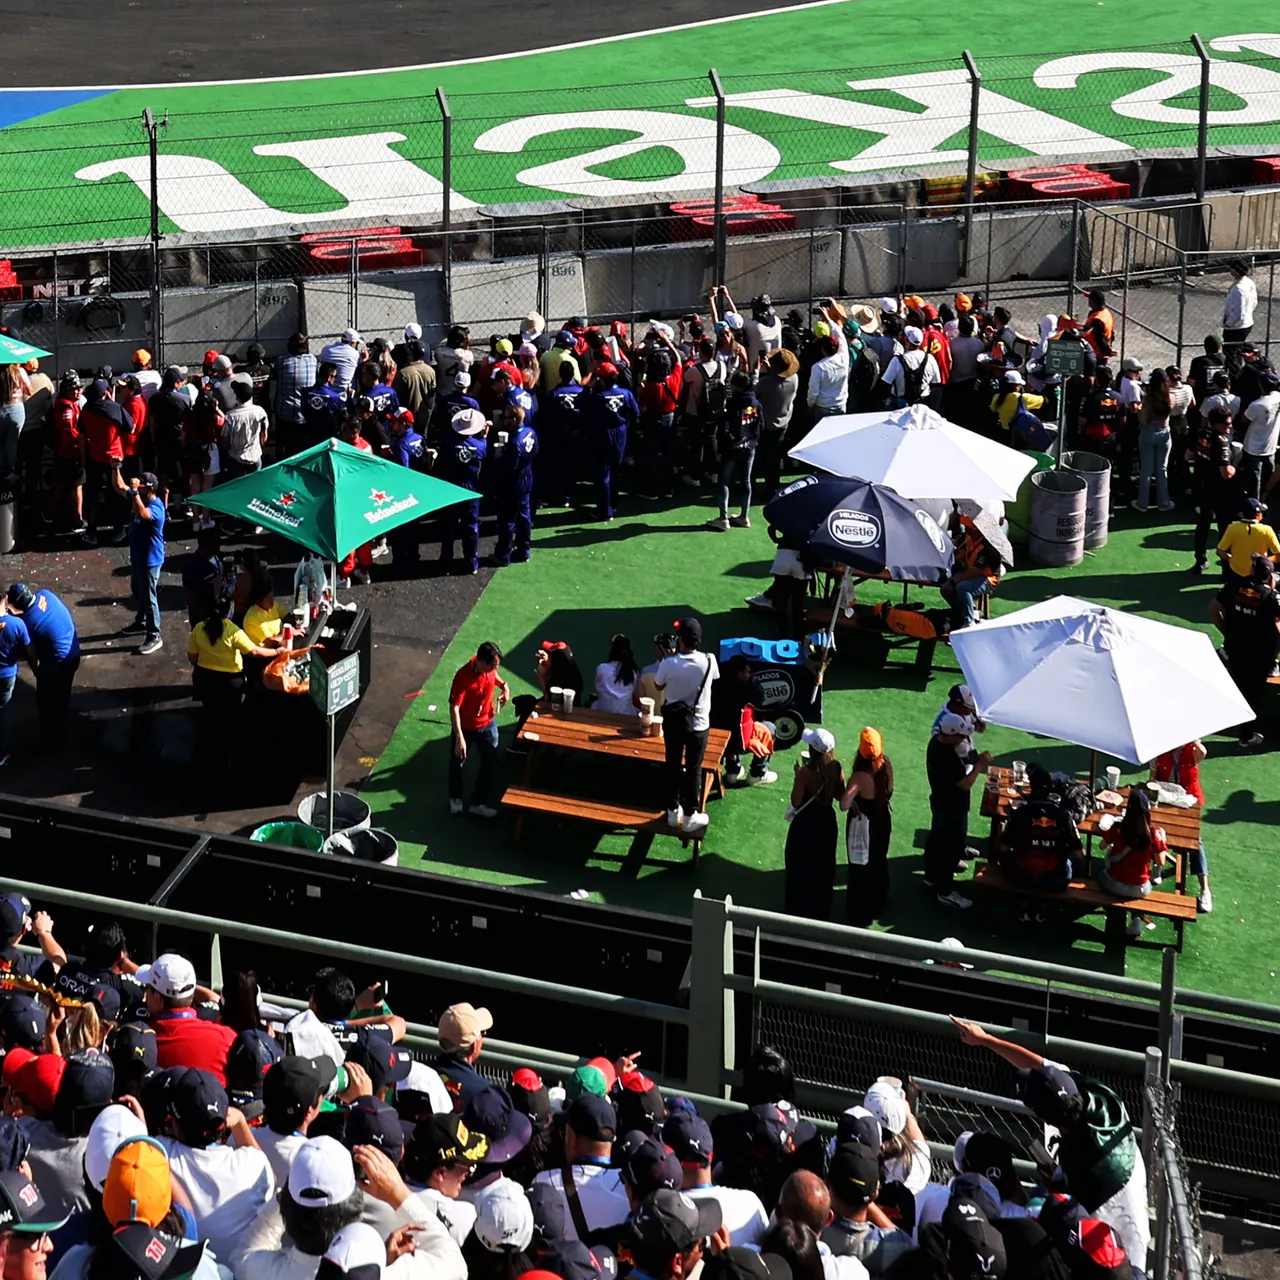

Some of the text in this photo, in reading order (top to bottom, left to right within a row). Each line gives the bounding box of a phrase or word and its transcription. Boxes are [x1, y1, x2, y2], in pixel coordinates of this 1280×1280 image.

[551, 266, 576, 277] 896
[32, 277, 86, 299] NET
[246, 497, 305, 528] Heineken
[363, 493, 420, 525] Heineken
[839, 512, 870, 522] HELADOS
[19, 1183, 39, 1208] 11
[145, 1236, 167, 1263] 11
